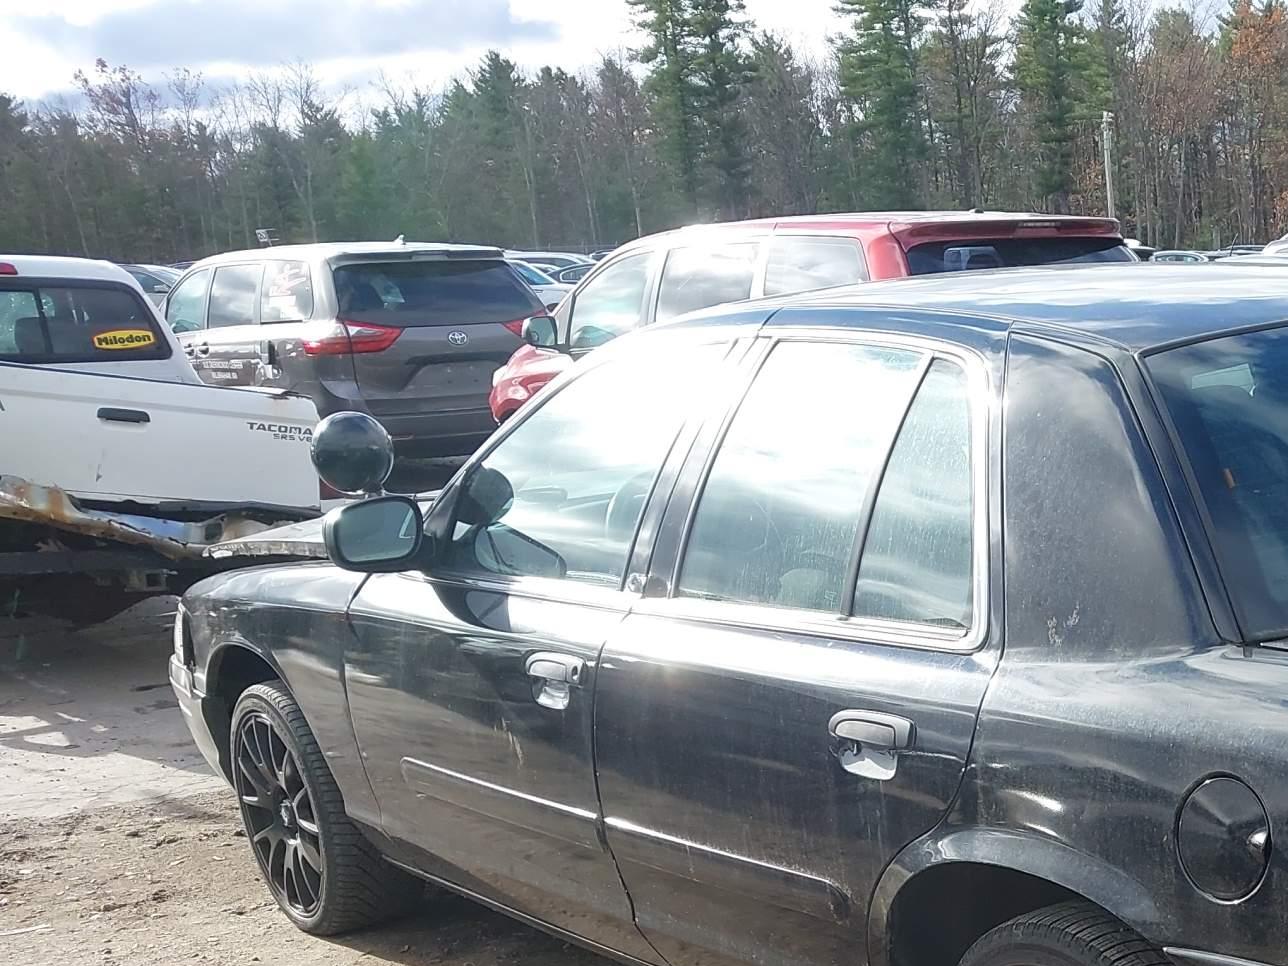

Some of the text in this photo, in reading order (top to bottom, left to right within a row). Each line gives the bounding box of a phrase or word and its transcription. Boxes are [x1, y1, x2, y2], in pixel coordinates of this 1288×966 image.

[96, 334, 151, 345] Milodon
[247, 422, 313, 435] TACOMA
[272, 433, 296, 441] SRS
